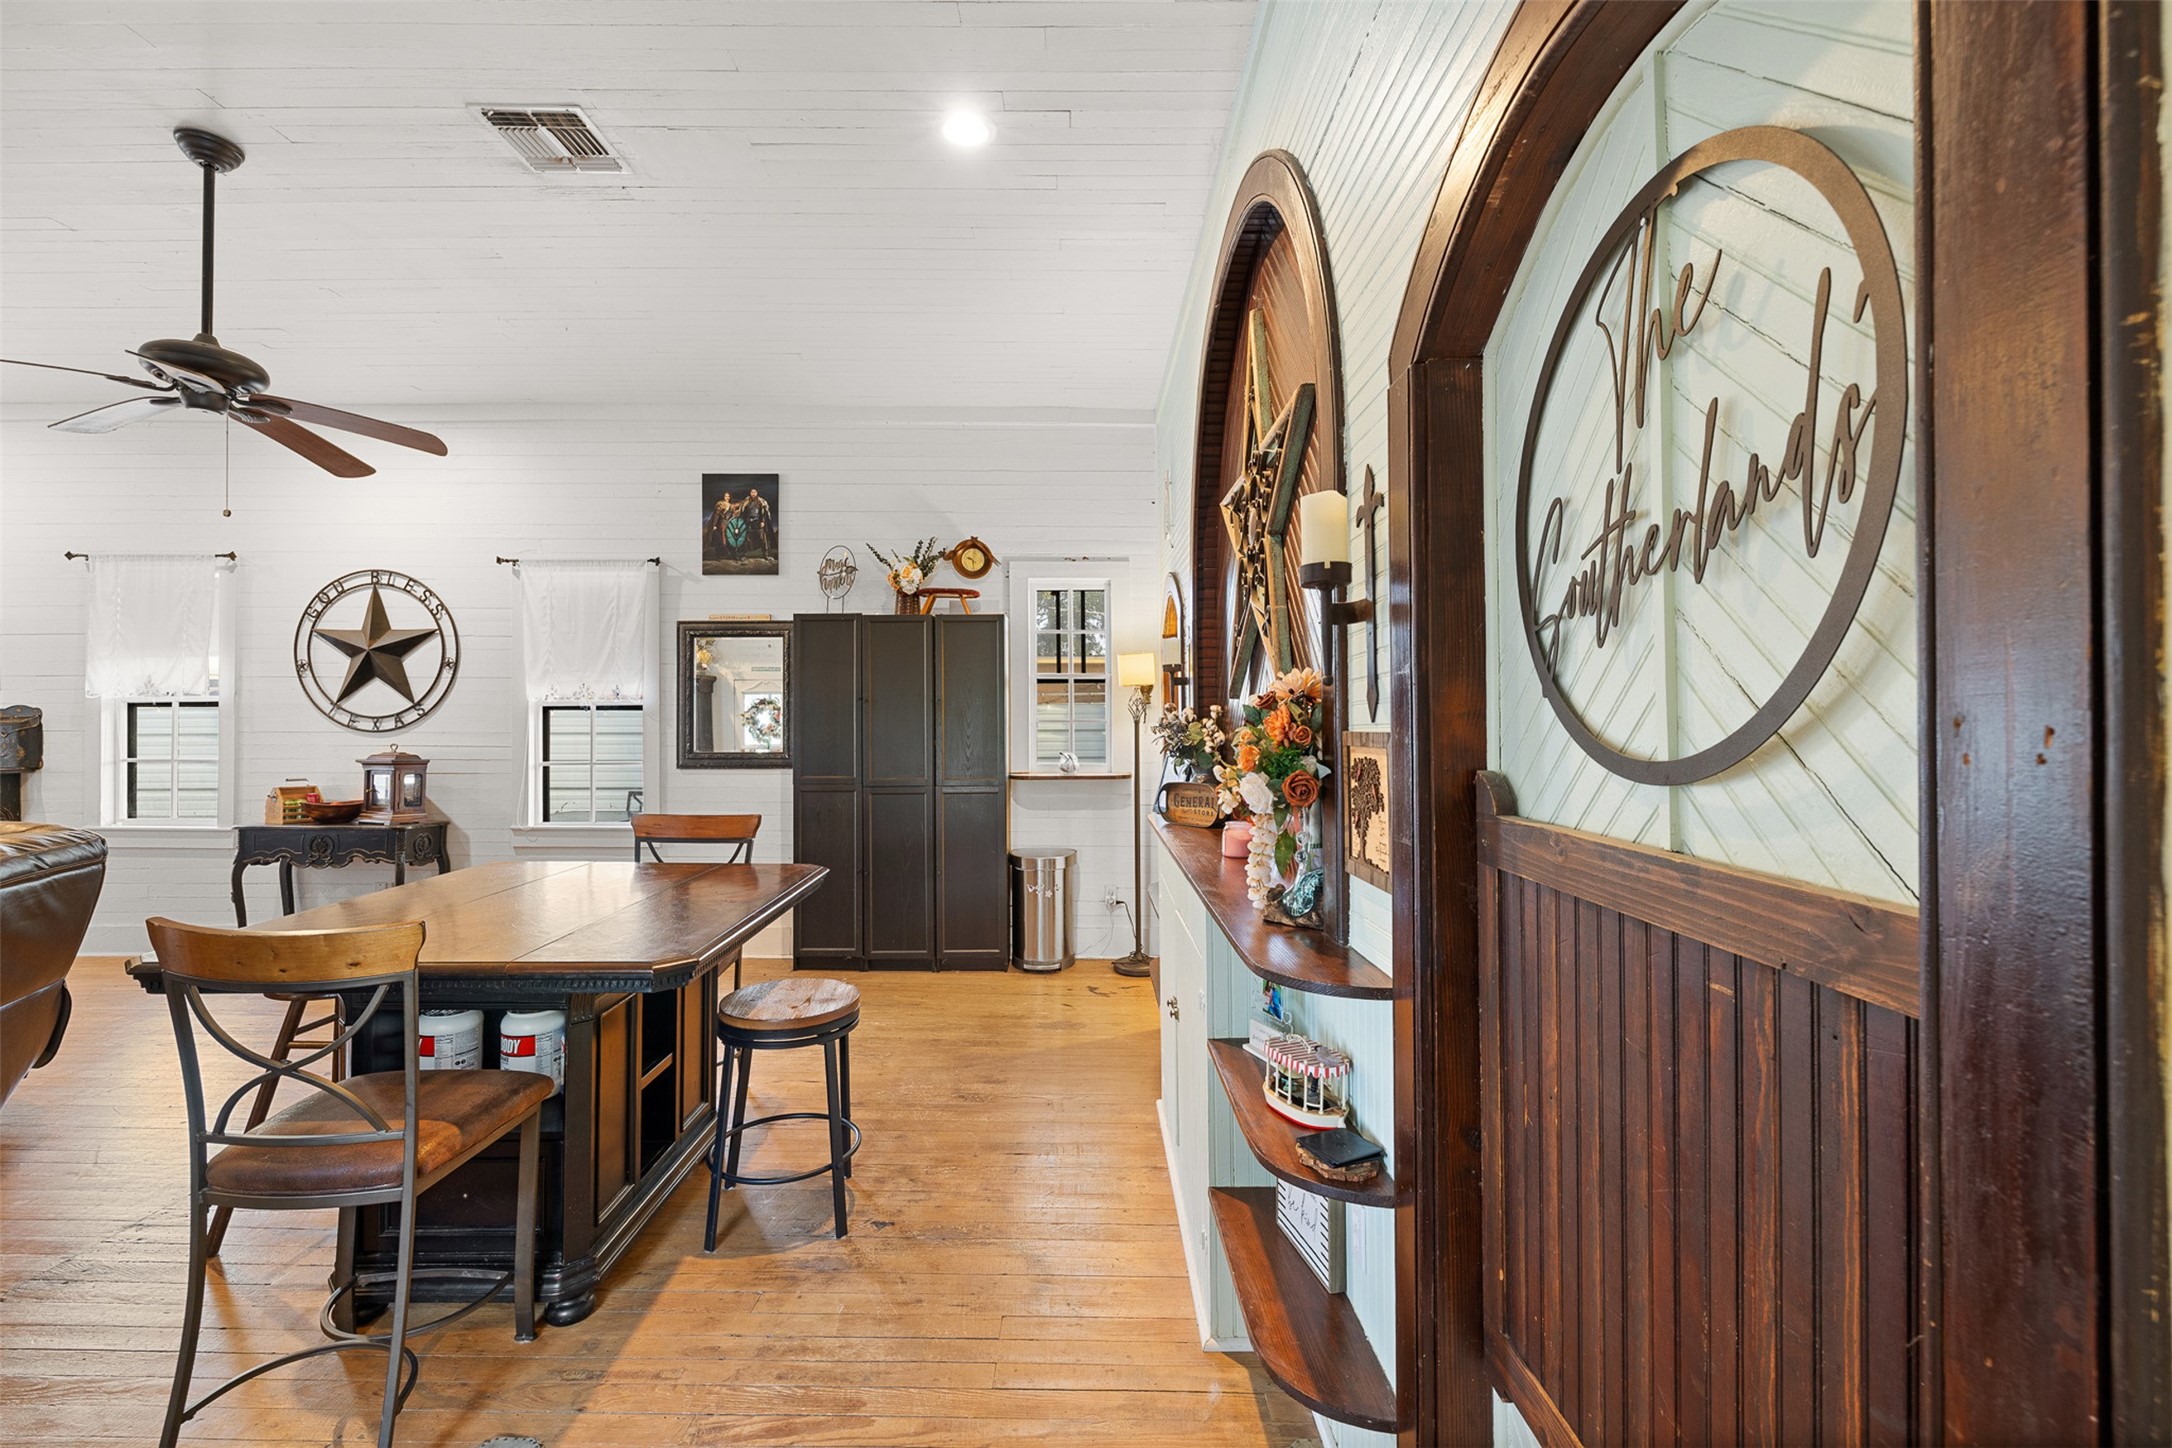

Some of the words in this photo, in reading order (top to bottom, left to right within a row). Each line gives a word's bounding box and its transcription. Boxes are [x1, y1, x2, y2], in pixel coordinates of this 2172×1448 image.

[1596, 180, 1722, 475] The
[305, 579, 345, 619] GOD
[370, 569, 446, 616] BLESS
[327, 701, 427, 731] TEXAS
[1173, 793, 1216, 809] GENERAL
[1193, 808, 1214, 817] STORE
